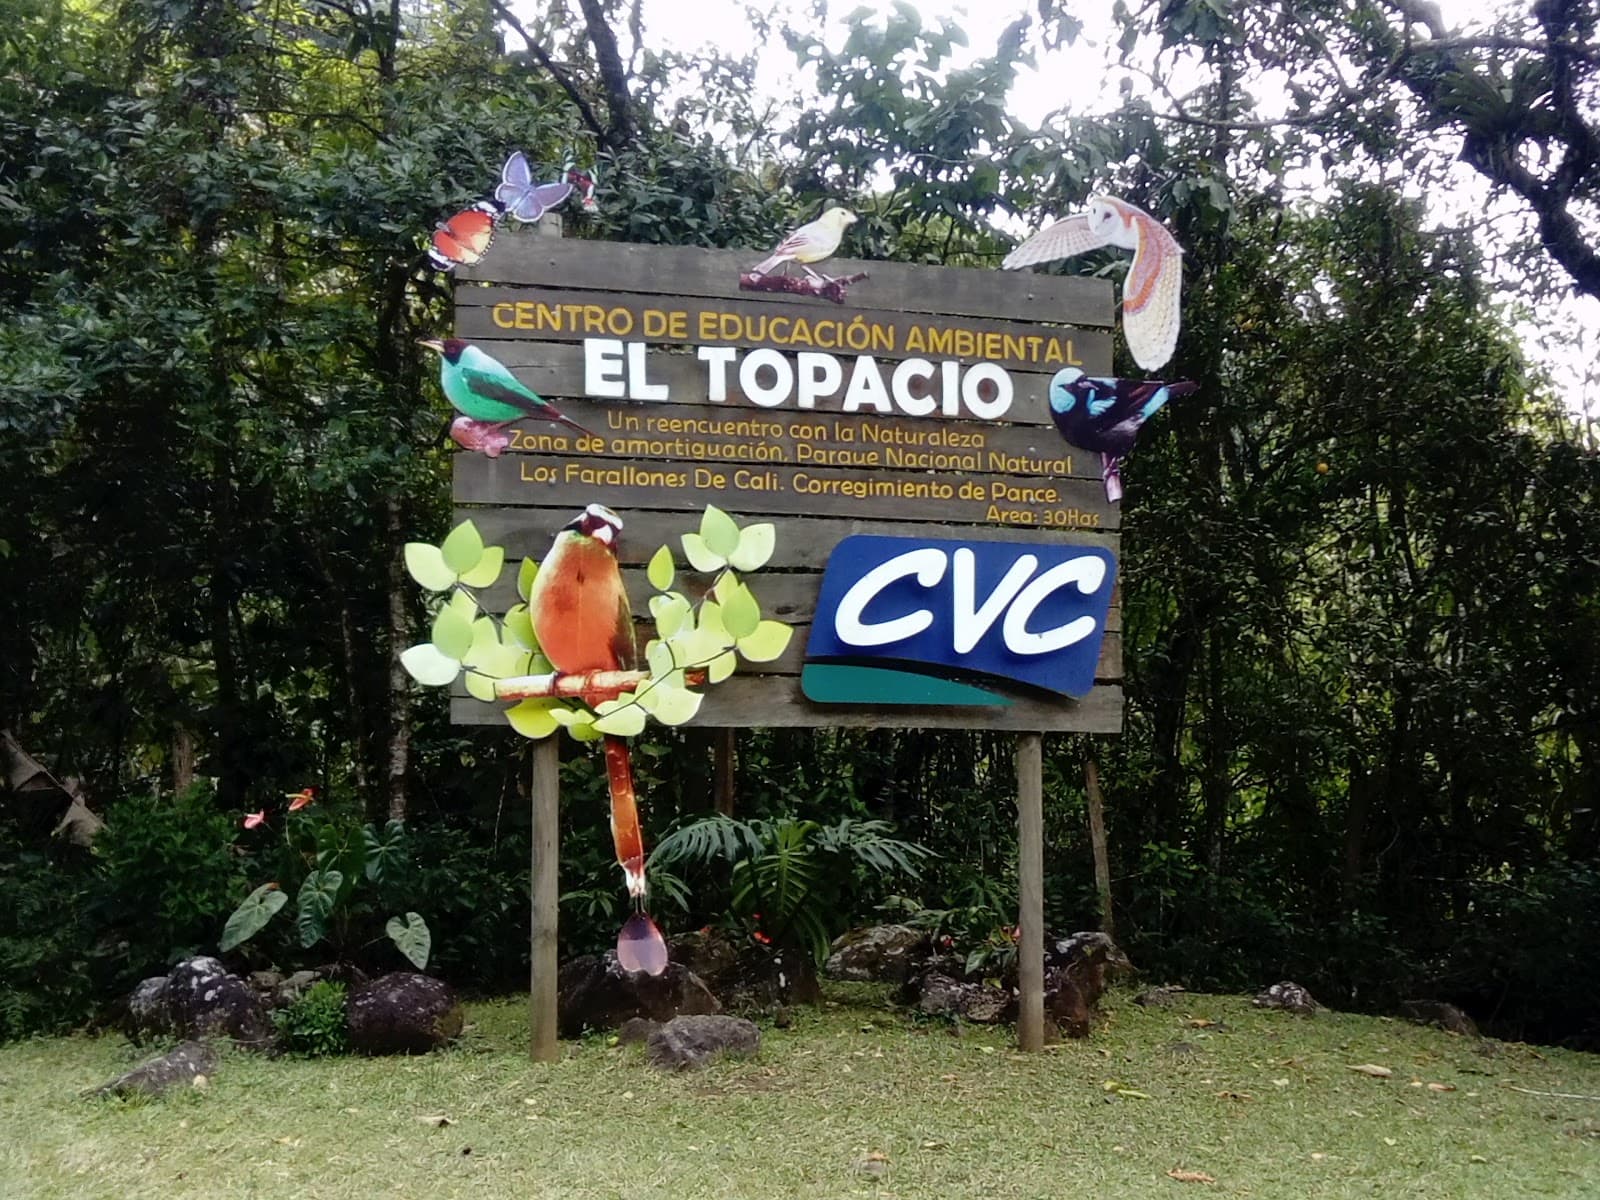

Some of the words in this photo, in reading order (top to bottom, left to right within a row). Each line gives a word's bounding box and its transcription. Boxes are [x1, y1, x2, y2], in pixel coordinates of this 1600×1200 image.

[492, 302, 633, 336] CENTRO
[643, 309, 688, 339] DE
[699, 311, 894, 351] EDUCACIÓN
[905, 325, 1083, 366] AMBIENTAL
[584, 338, 669, 400] EL
[698, 346, 1014, 420] TOPACIO
[509, 430, 567, 451] Zona
[575, 433, 605, 452] de
[886, 447, 981, 471] Nacional
[989, 452, 1072, 475] Natural
[608, 410, 639, 431] Un
[647, 416, 783, 439] reencuentro
[789, 422, 826, 441] con
[834, 421, 854, 442] la
[862, 423, 985, 449] Naturaleza
[520, 461, 556, 483] Los
[565, 464, 687, 488] Farallones
[695, 469, 726, 489] De
[734, 470, 784, 491] Cali.
[793, 474, 953, 499] Corregimiento
[958, 480, 985, 501] de
[991, 482, 1062, 504] Pance.
[834, 546, 1107, 656] CVC
